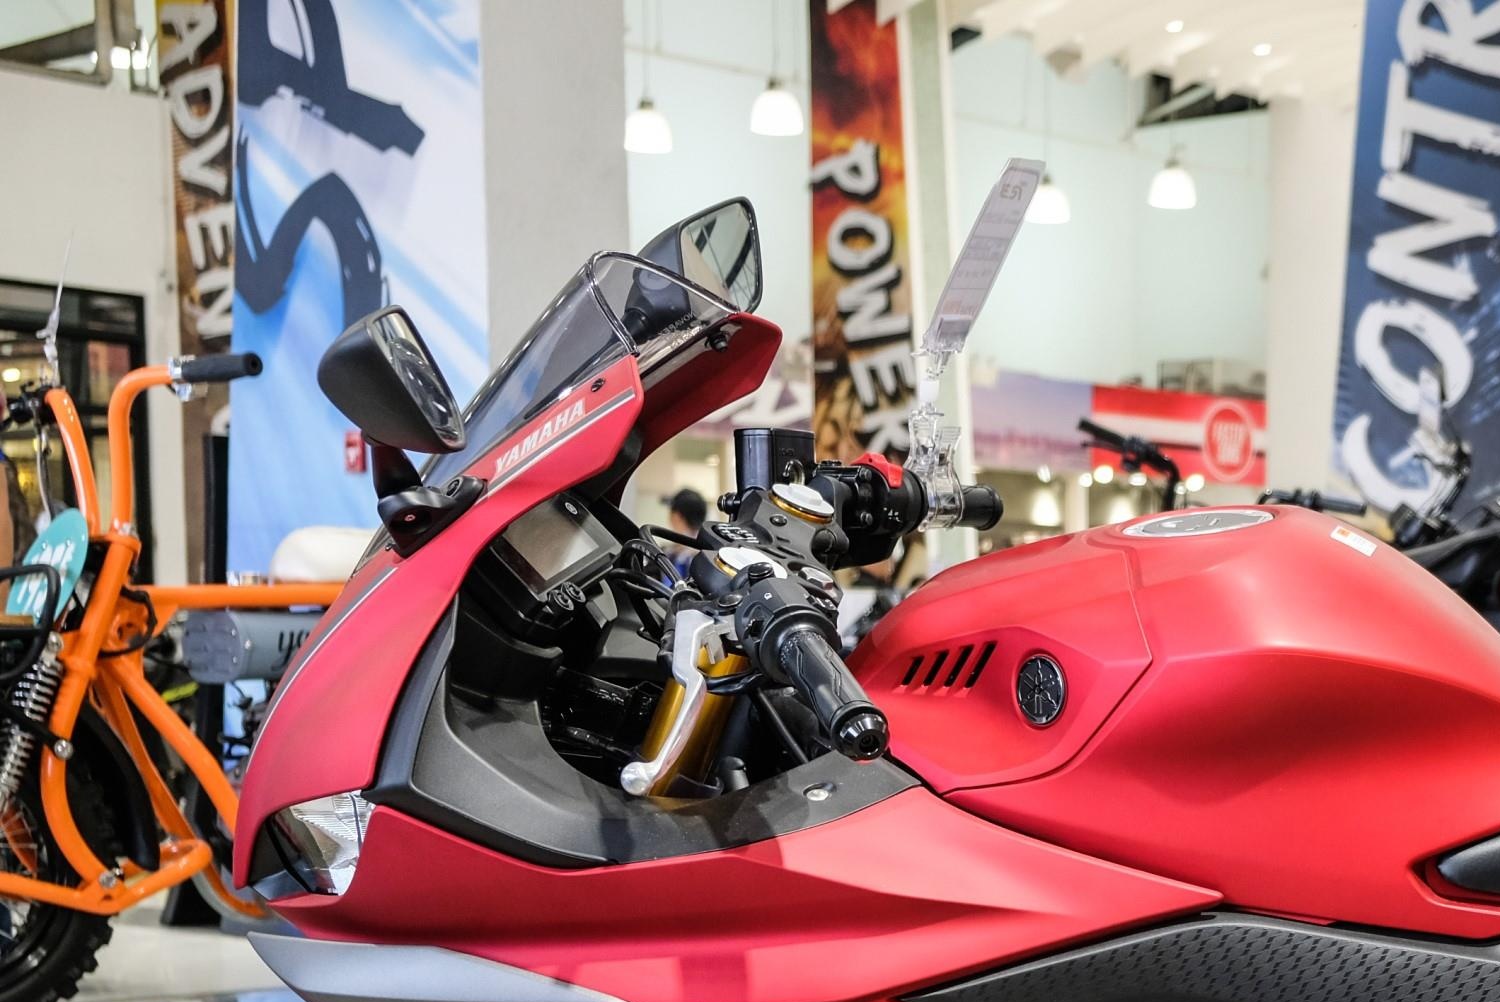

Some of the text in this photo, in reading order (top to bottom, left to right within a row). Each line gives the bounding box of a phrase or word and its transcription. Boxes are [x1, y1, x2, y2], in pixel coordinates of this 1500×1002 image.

[158, 2, 234, 342] ADVEN
[811, 138, 915, 456] POWER
[494, 397, 586, 474] YAMAHA
